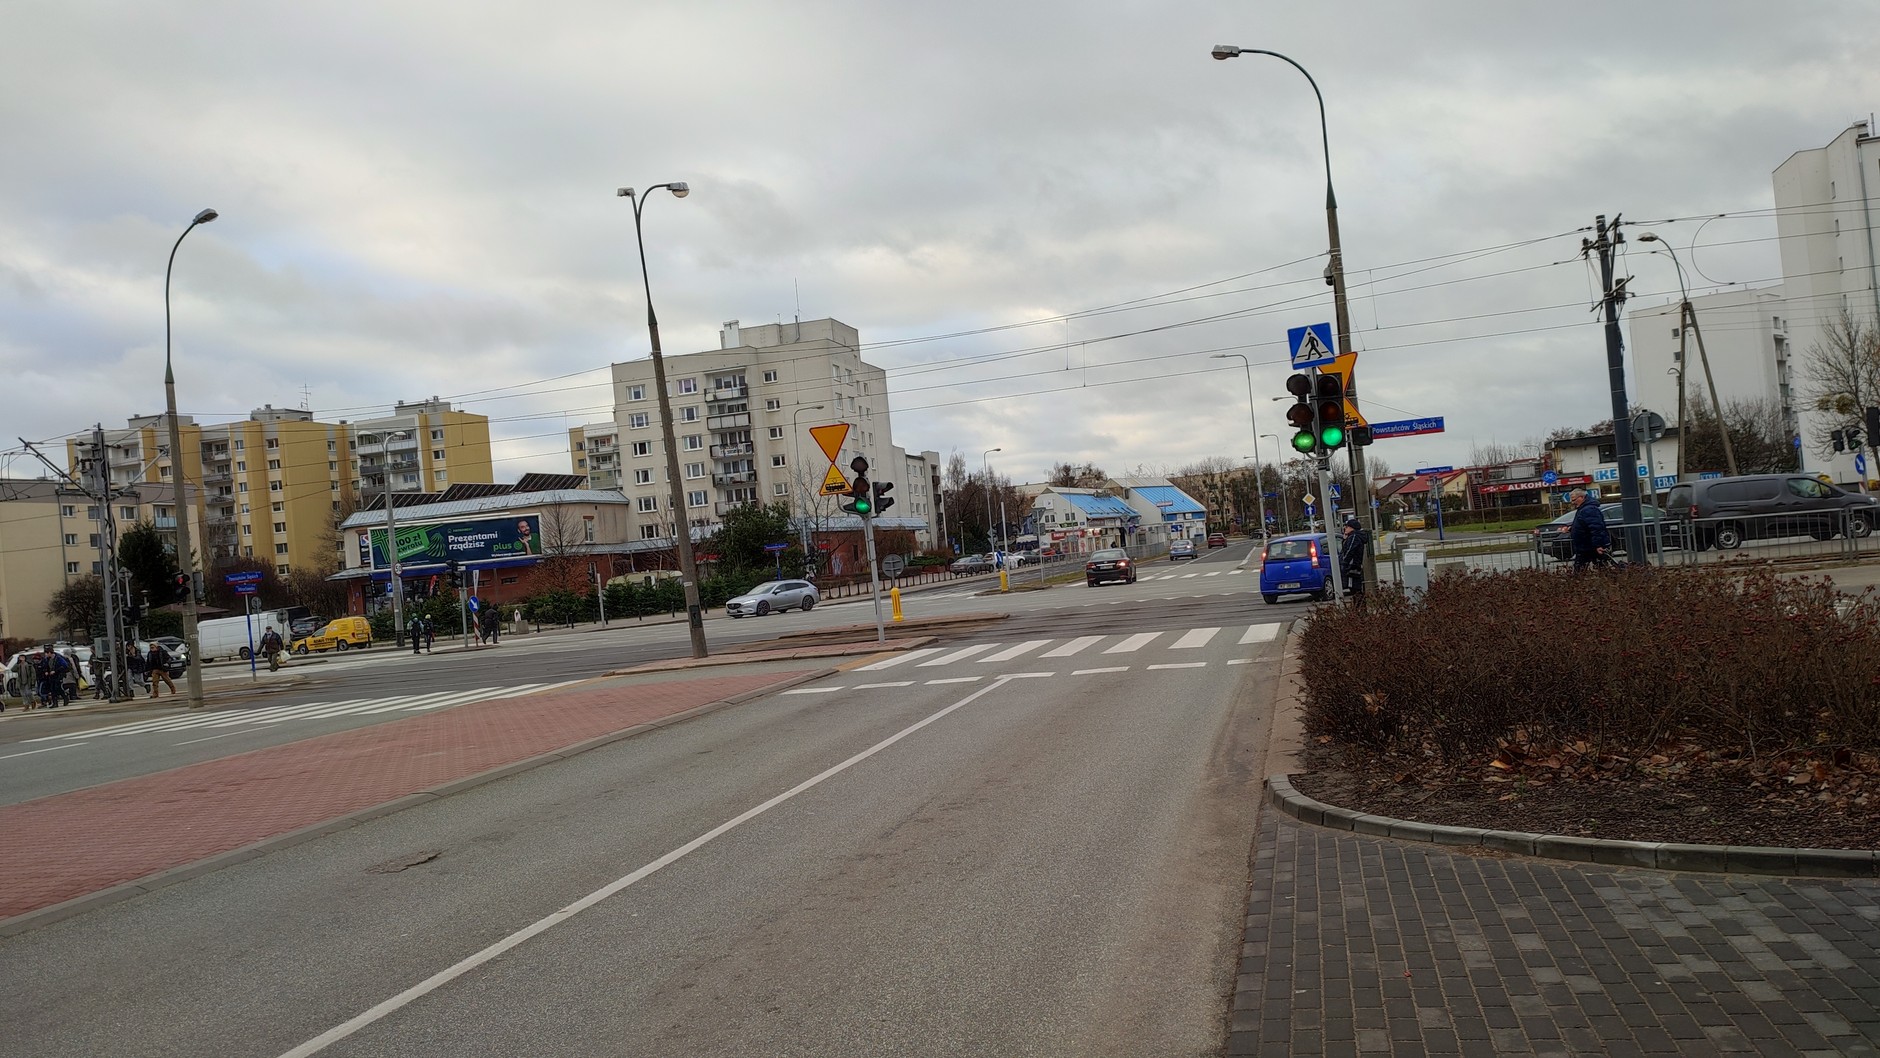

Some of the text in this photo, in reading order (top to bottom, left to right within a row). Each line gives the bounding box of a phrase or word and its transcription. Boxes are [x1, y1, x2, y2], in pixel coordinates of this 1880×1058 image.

[1372, 421, 1437, 434] Powstańców Śląskich
[1599, 465, 1648, 480] KEB
[395, 532, 421, 547] 100 zł
[448, 530, 498, 543] Prezentami
[397, 540, 423, 553] zwrotu
[449, 540, 485, 551] rządzisz
[493, 542, 512, 552] plus
